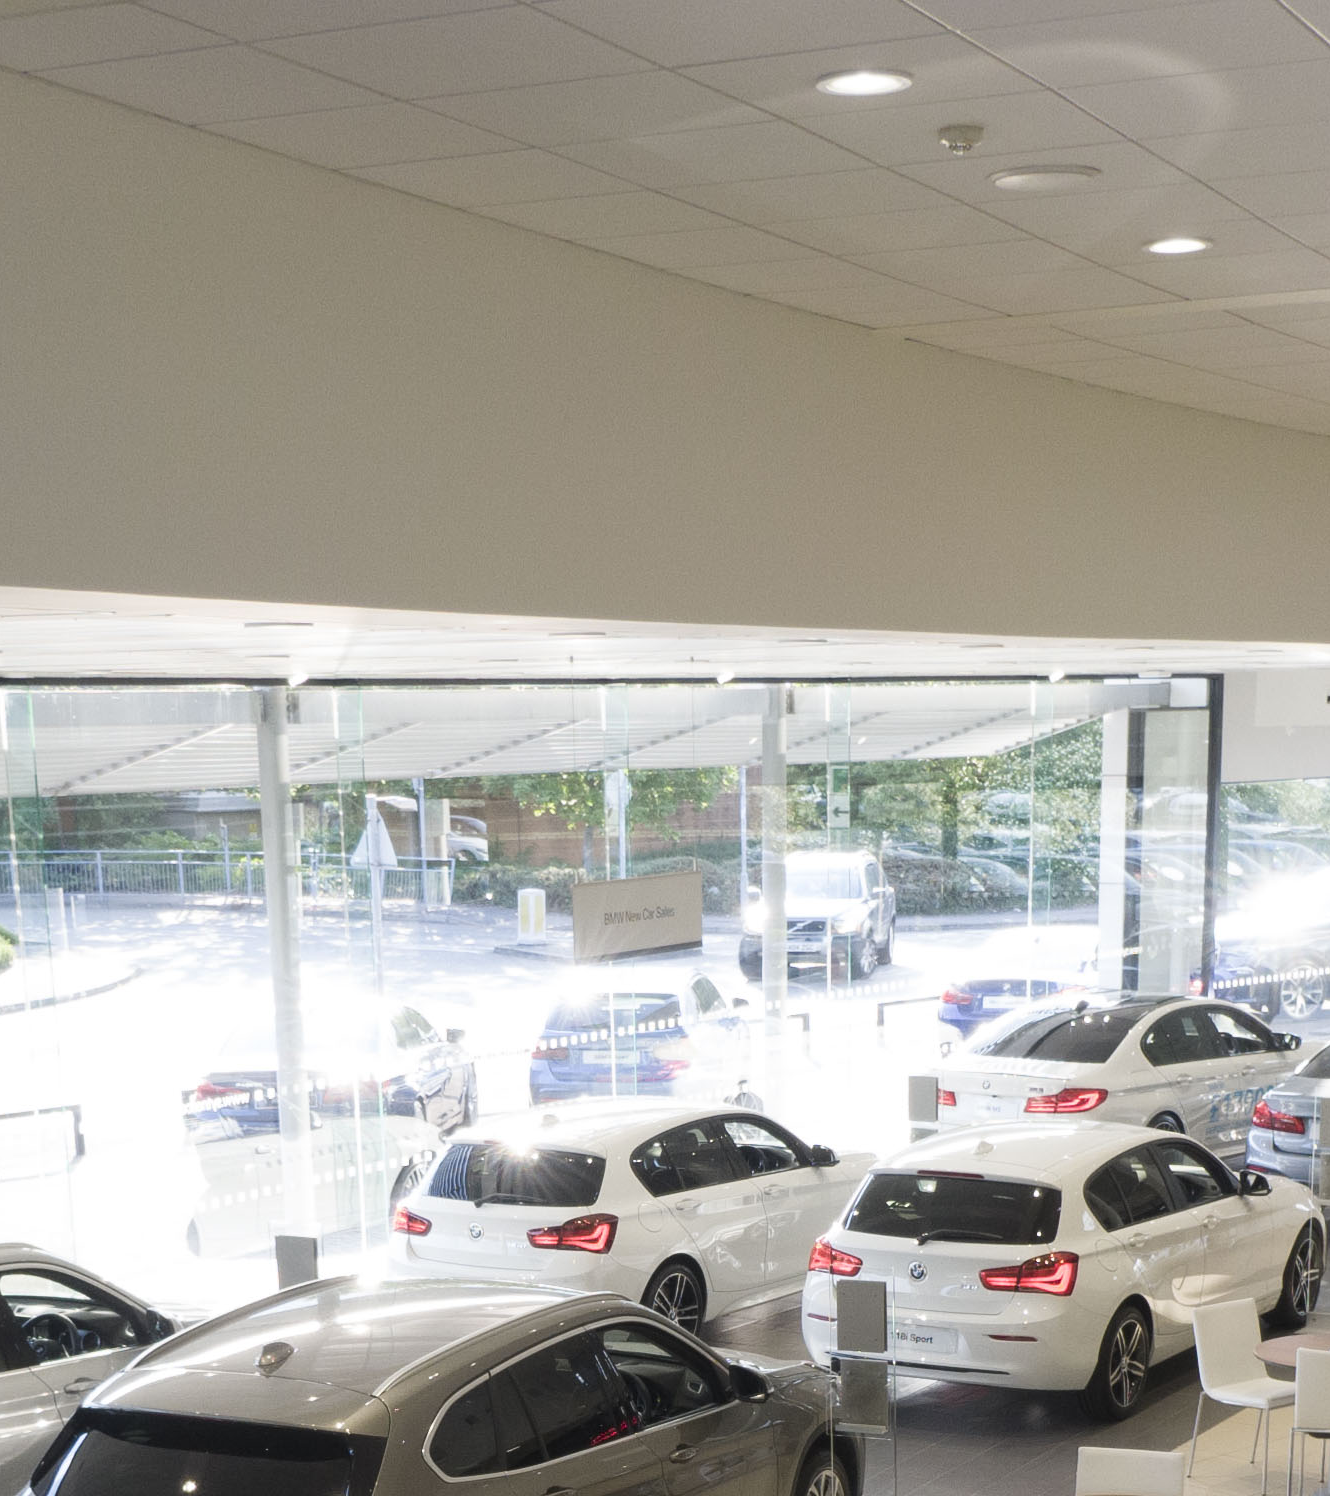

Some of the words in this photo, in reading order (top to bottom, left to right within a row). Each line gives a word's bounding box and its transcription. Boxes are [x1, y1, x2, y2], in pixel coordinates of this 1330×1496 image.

[604, 911, 624, 926] BMW
[625, 910, 642, 923] New
[643, 907, 655, 921] Car
[656, 905, 676, 919] Sales
[909, 1333, 934, 1344] Sport
